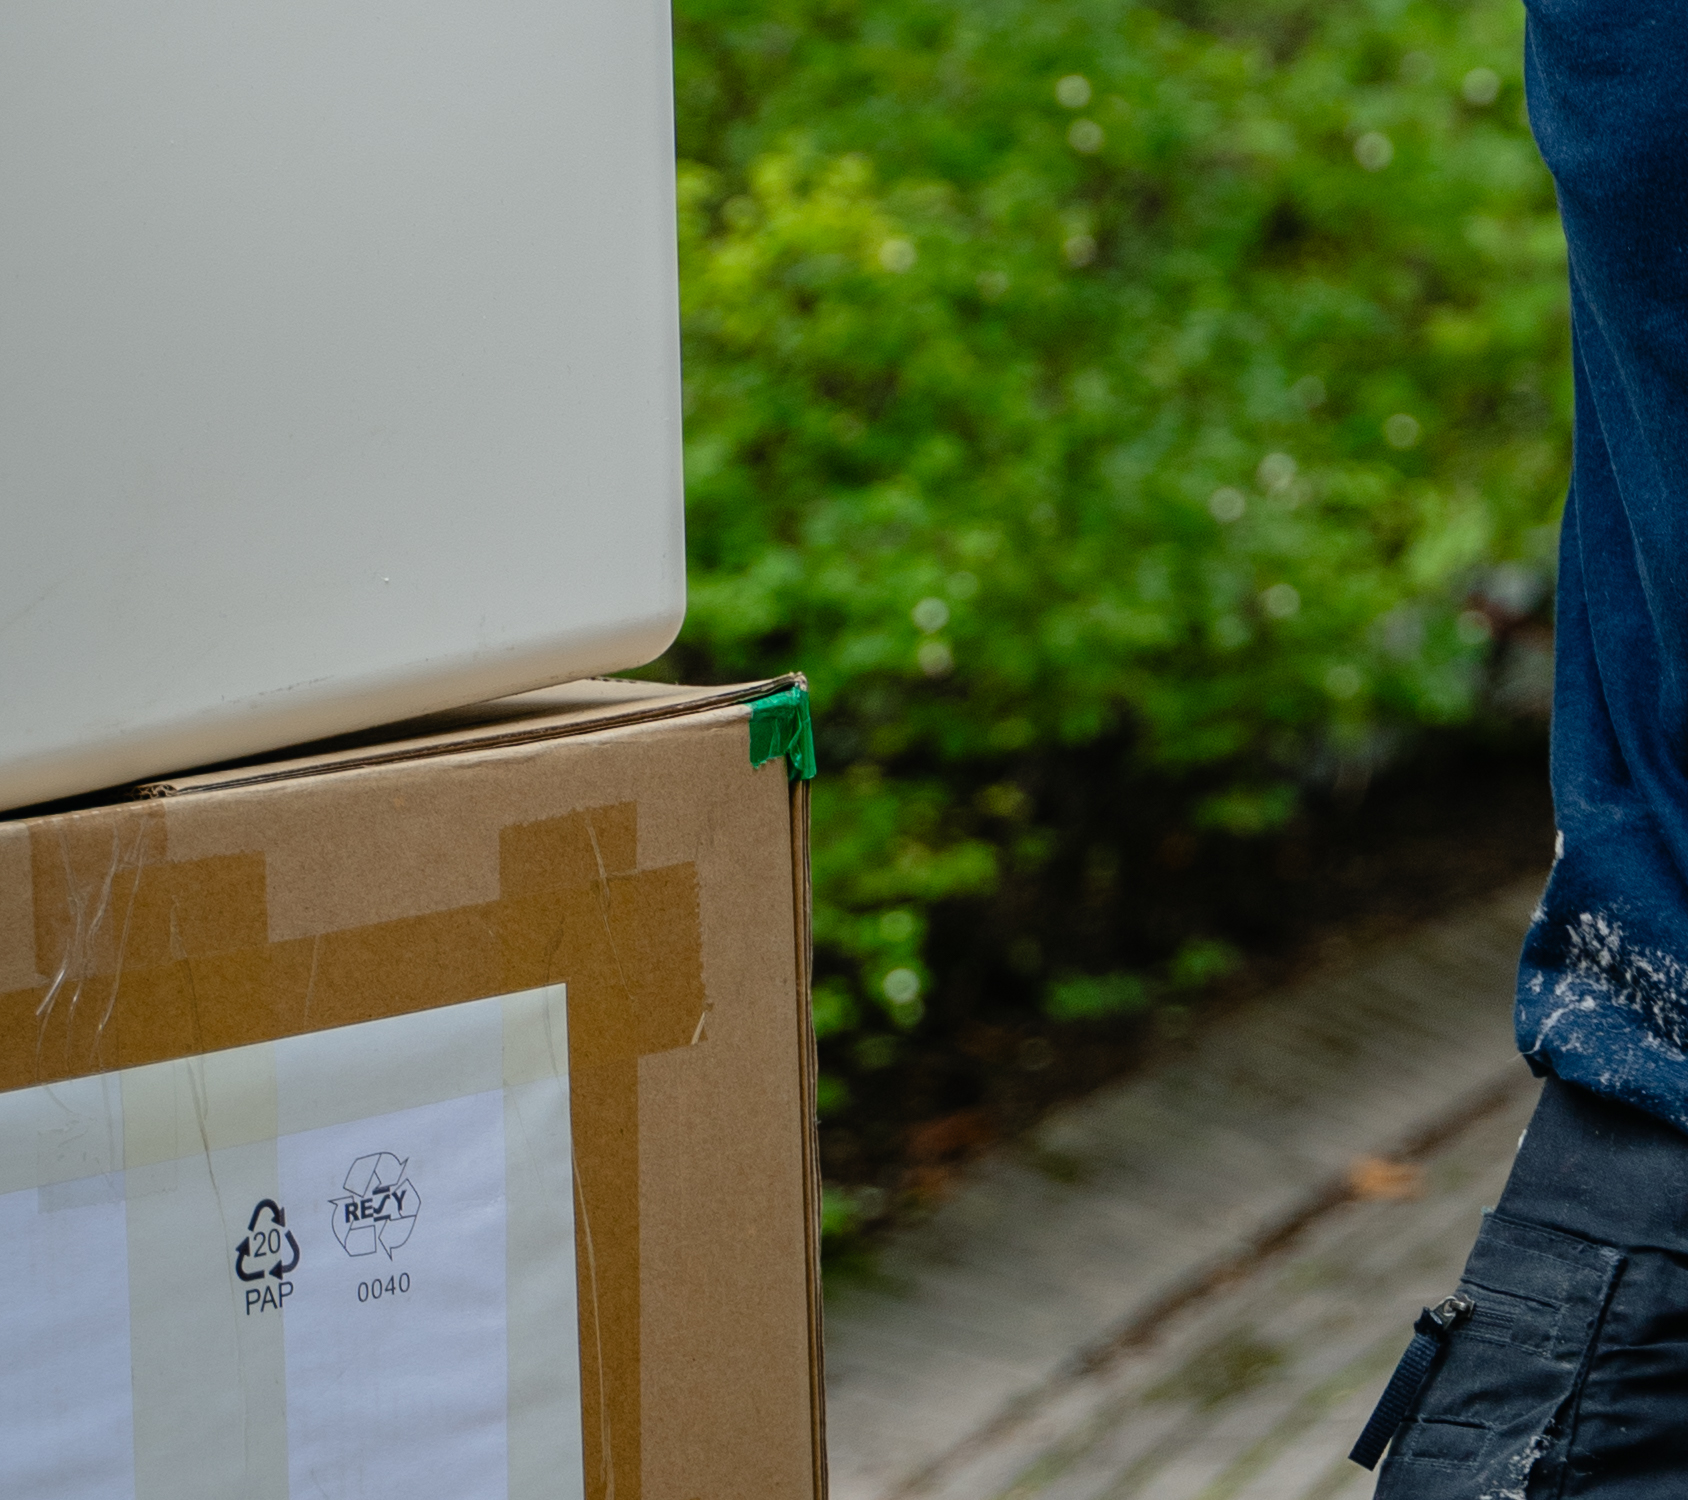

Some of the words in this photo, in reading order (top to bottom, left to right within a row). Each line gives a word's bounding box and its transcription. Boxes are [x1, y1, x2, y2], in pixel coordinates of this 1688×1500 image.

[253, 1228, 282, 1259] 20
[245, 1281, 294, 1316] PAP
[357, 1272, 411, 1302] 0040
